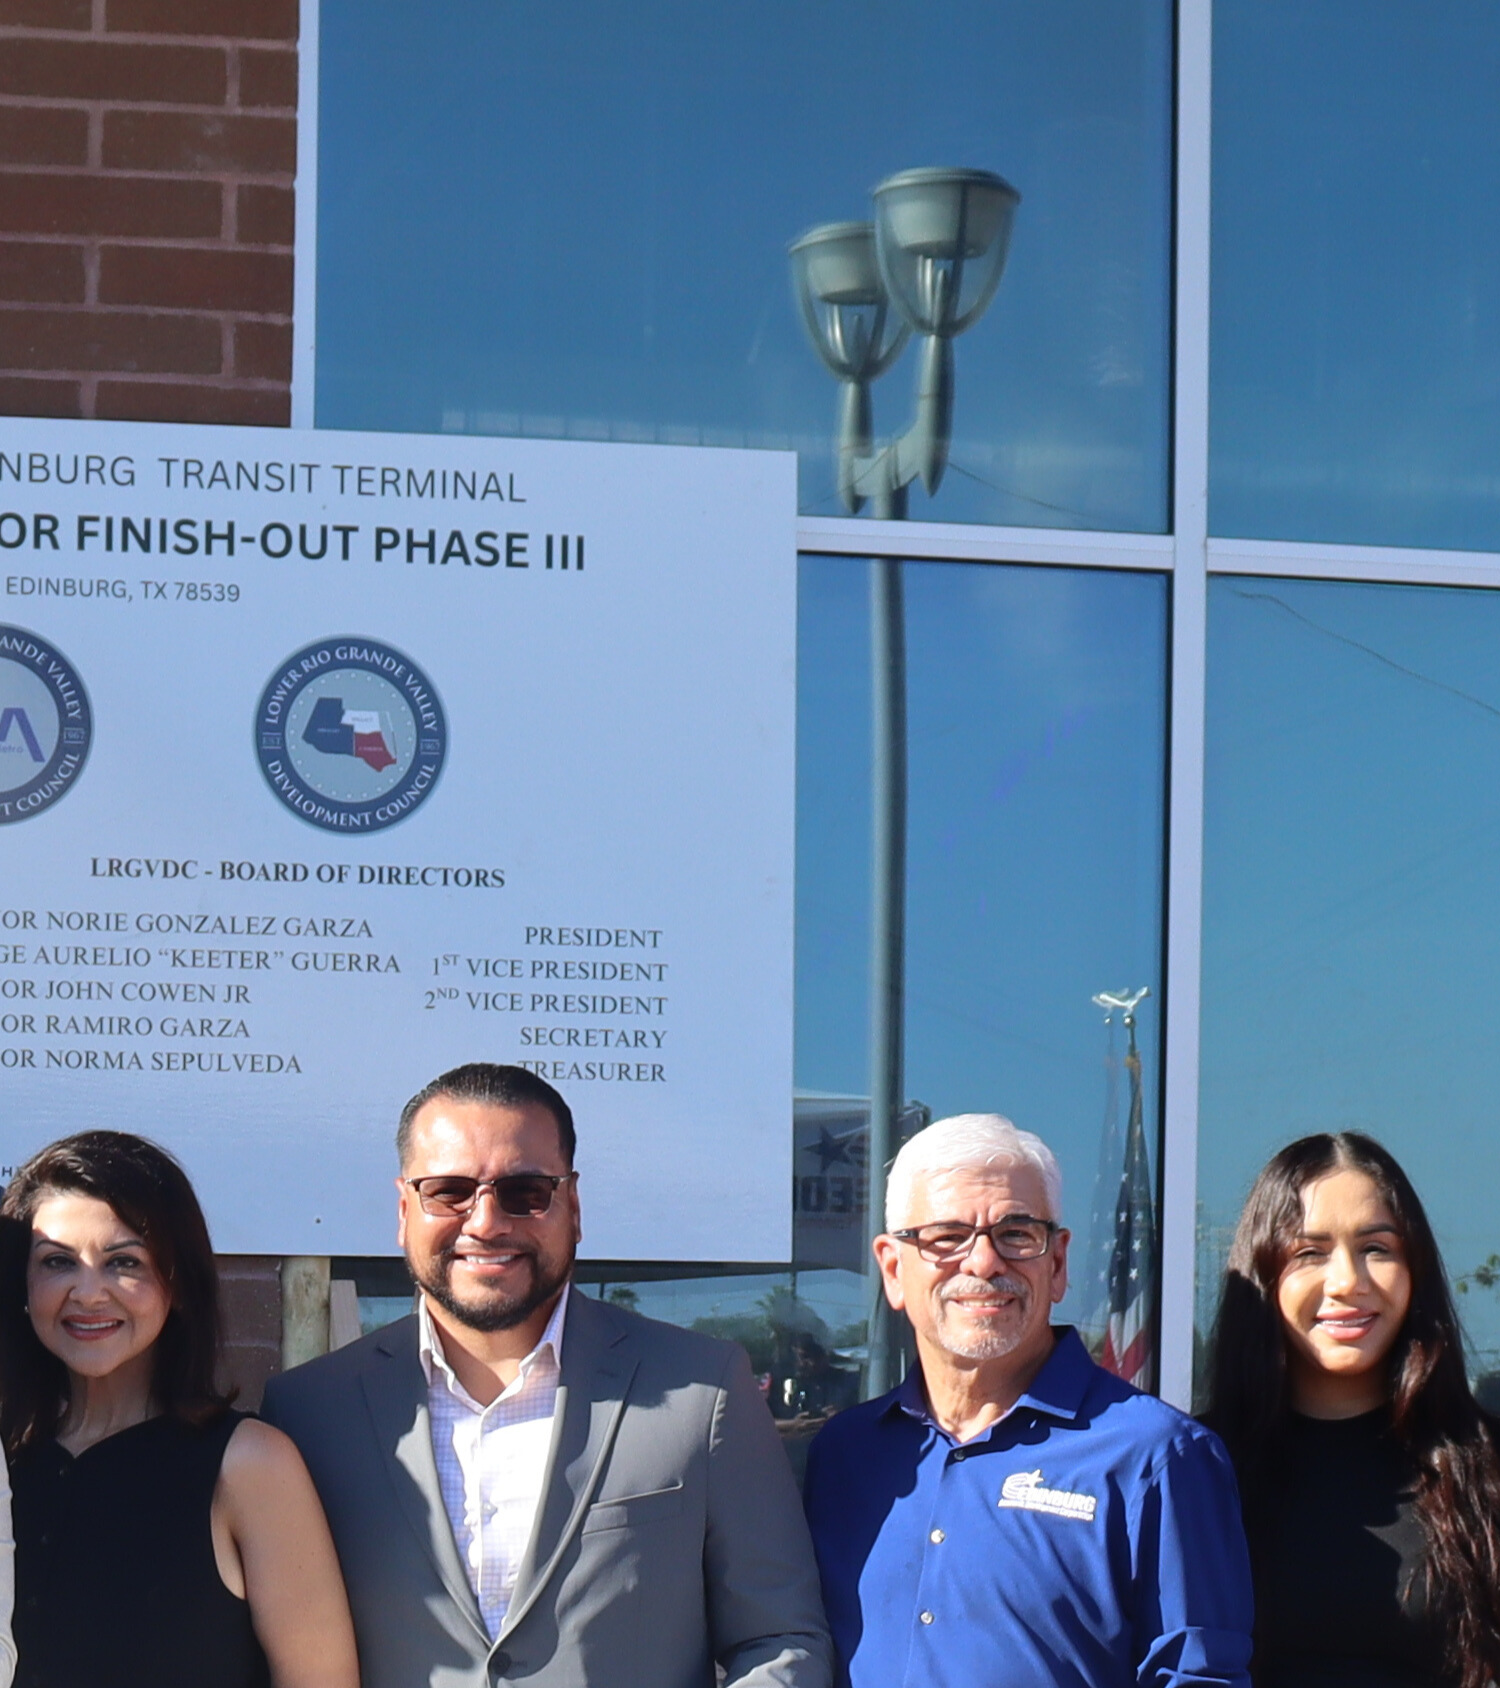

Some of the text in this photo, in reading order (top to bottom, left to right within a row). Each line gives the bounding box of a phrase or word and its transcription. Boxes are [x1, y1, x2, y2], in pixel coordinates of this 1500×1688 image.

[157, 458, 321, 494] TRANSIT
[331, 465, 527, 503] TERMINAL
[77, 515, 359, 561] FINISH-OUT
[375, 526, 529, 569] PHASE
[545, 534, 584, 571] III
[7, 576, 132, 602] EDINBURG,
[140, 581, 167, 599] TX
[174, 582, 240, 602] 78539
[47, 660, 82, 719] VALLEY
[265, 646, 437, 731] LOWER RIO GRANDE VALLEY
[16, 753, 80, 812] COUNCIL
[268, 760, 436, 827] DEVELOPMENT COUNCIL
[91, 858, 198, 879] LRGVDC
[220, 861, 309, 882] BOARD
[316, 864, 351, 883] OF
[358, 865, 505, 888] DIRECTORS
[47, 911, 128, 931] NORIE
[136, 914, 276, 935] GONZALEZ
[283, 917, 373, 938] GARZA
[525, 927, 662, 948] PRESIDENT
[33, 946, 151, 967] AURELIO
[158, 949, 284, 969] “KEETER”
[291, 952, 400, 973] GUERRA
[466, 959, 523, 978] VICE
[532, 960, 668, 982] PRESIDENT
[45, 980, 113, 1000] JOHN
[121, 982, 215, 1002] COWEN
[223, 985, 251, 1003] JR
[466, 992, 523, 1011] VICE
[530, 994, 668, 1015] PRESIDENT
[45, 1015, 153, 1036] RAMIRO
[160, 1018, 250, 1038] GARZA
[520, 1027, 667, 1048] SECRETARY
[45, 1050, 144, 1070] NORMA
[151, 1052, 302, 1073] SEPULVEDA
[517, 1060, 666, 1083] TREASURER
